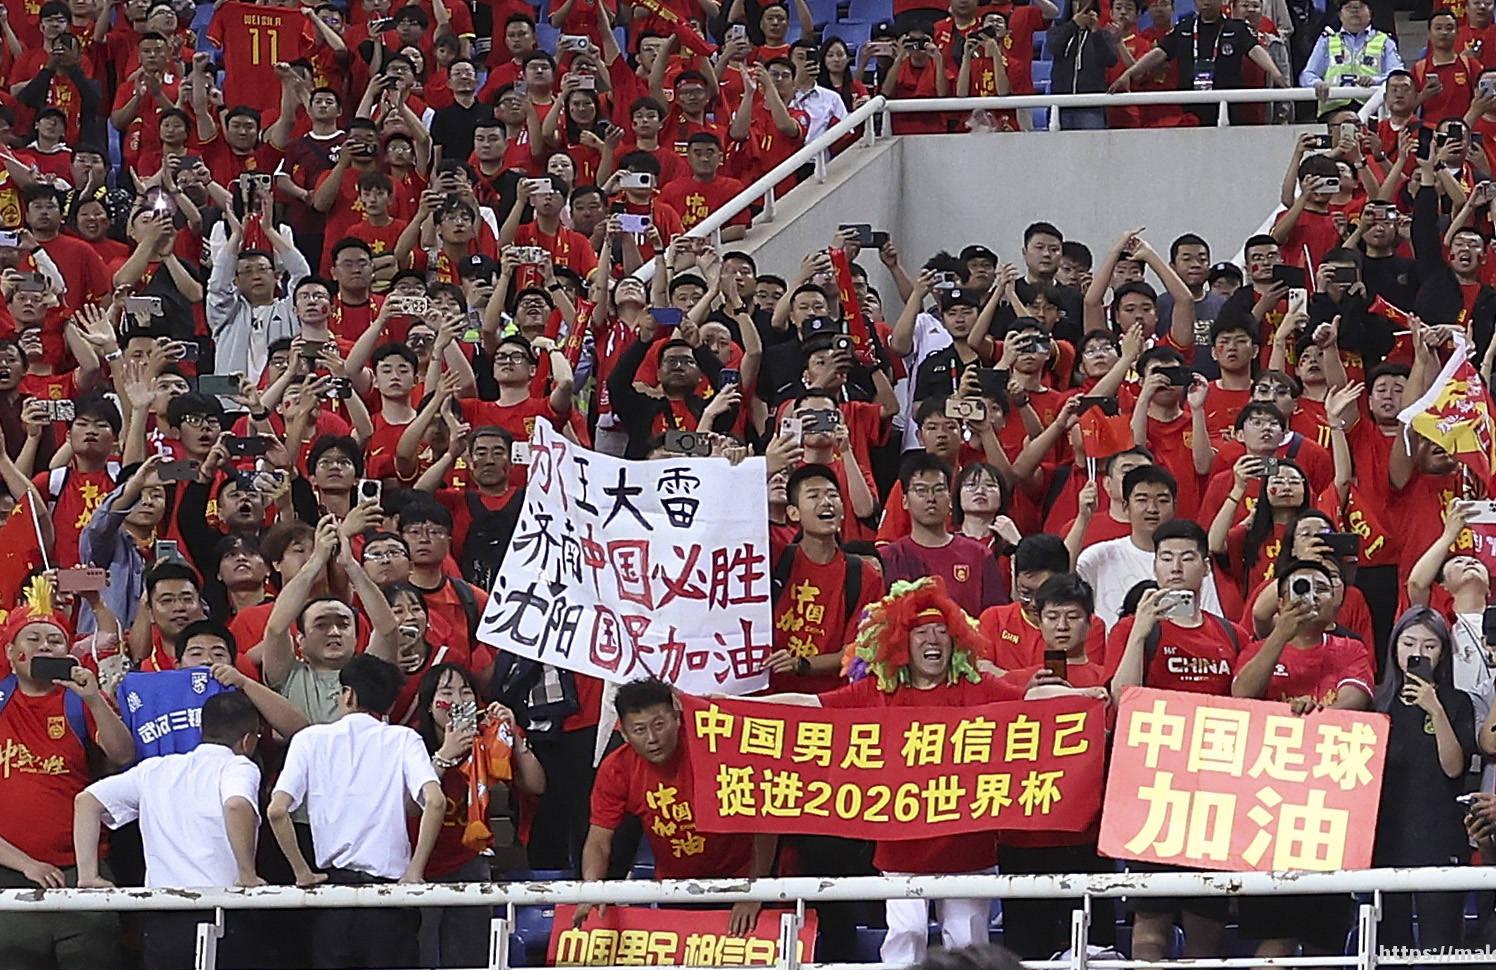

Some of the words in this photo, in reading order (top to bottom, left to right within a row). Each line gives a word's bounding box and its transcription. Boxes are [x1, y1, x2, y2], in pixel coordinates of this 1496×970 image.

[249, 28, 277, 65] 11
[1168, 657, 1230, 675] CHINA
[695, 704, 885, 769] 中国男足
[901, 711, 1089, 767] 相信自己
[1126, 699, 1378, 791] 中国足球
[717, 764, 1064, 824] 挺进2026世界杯
[1124, 771, 1350, 872] 加油
